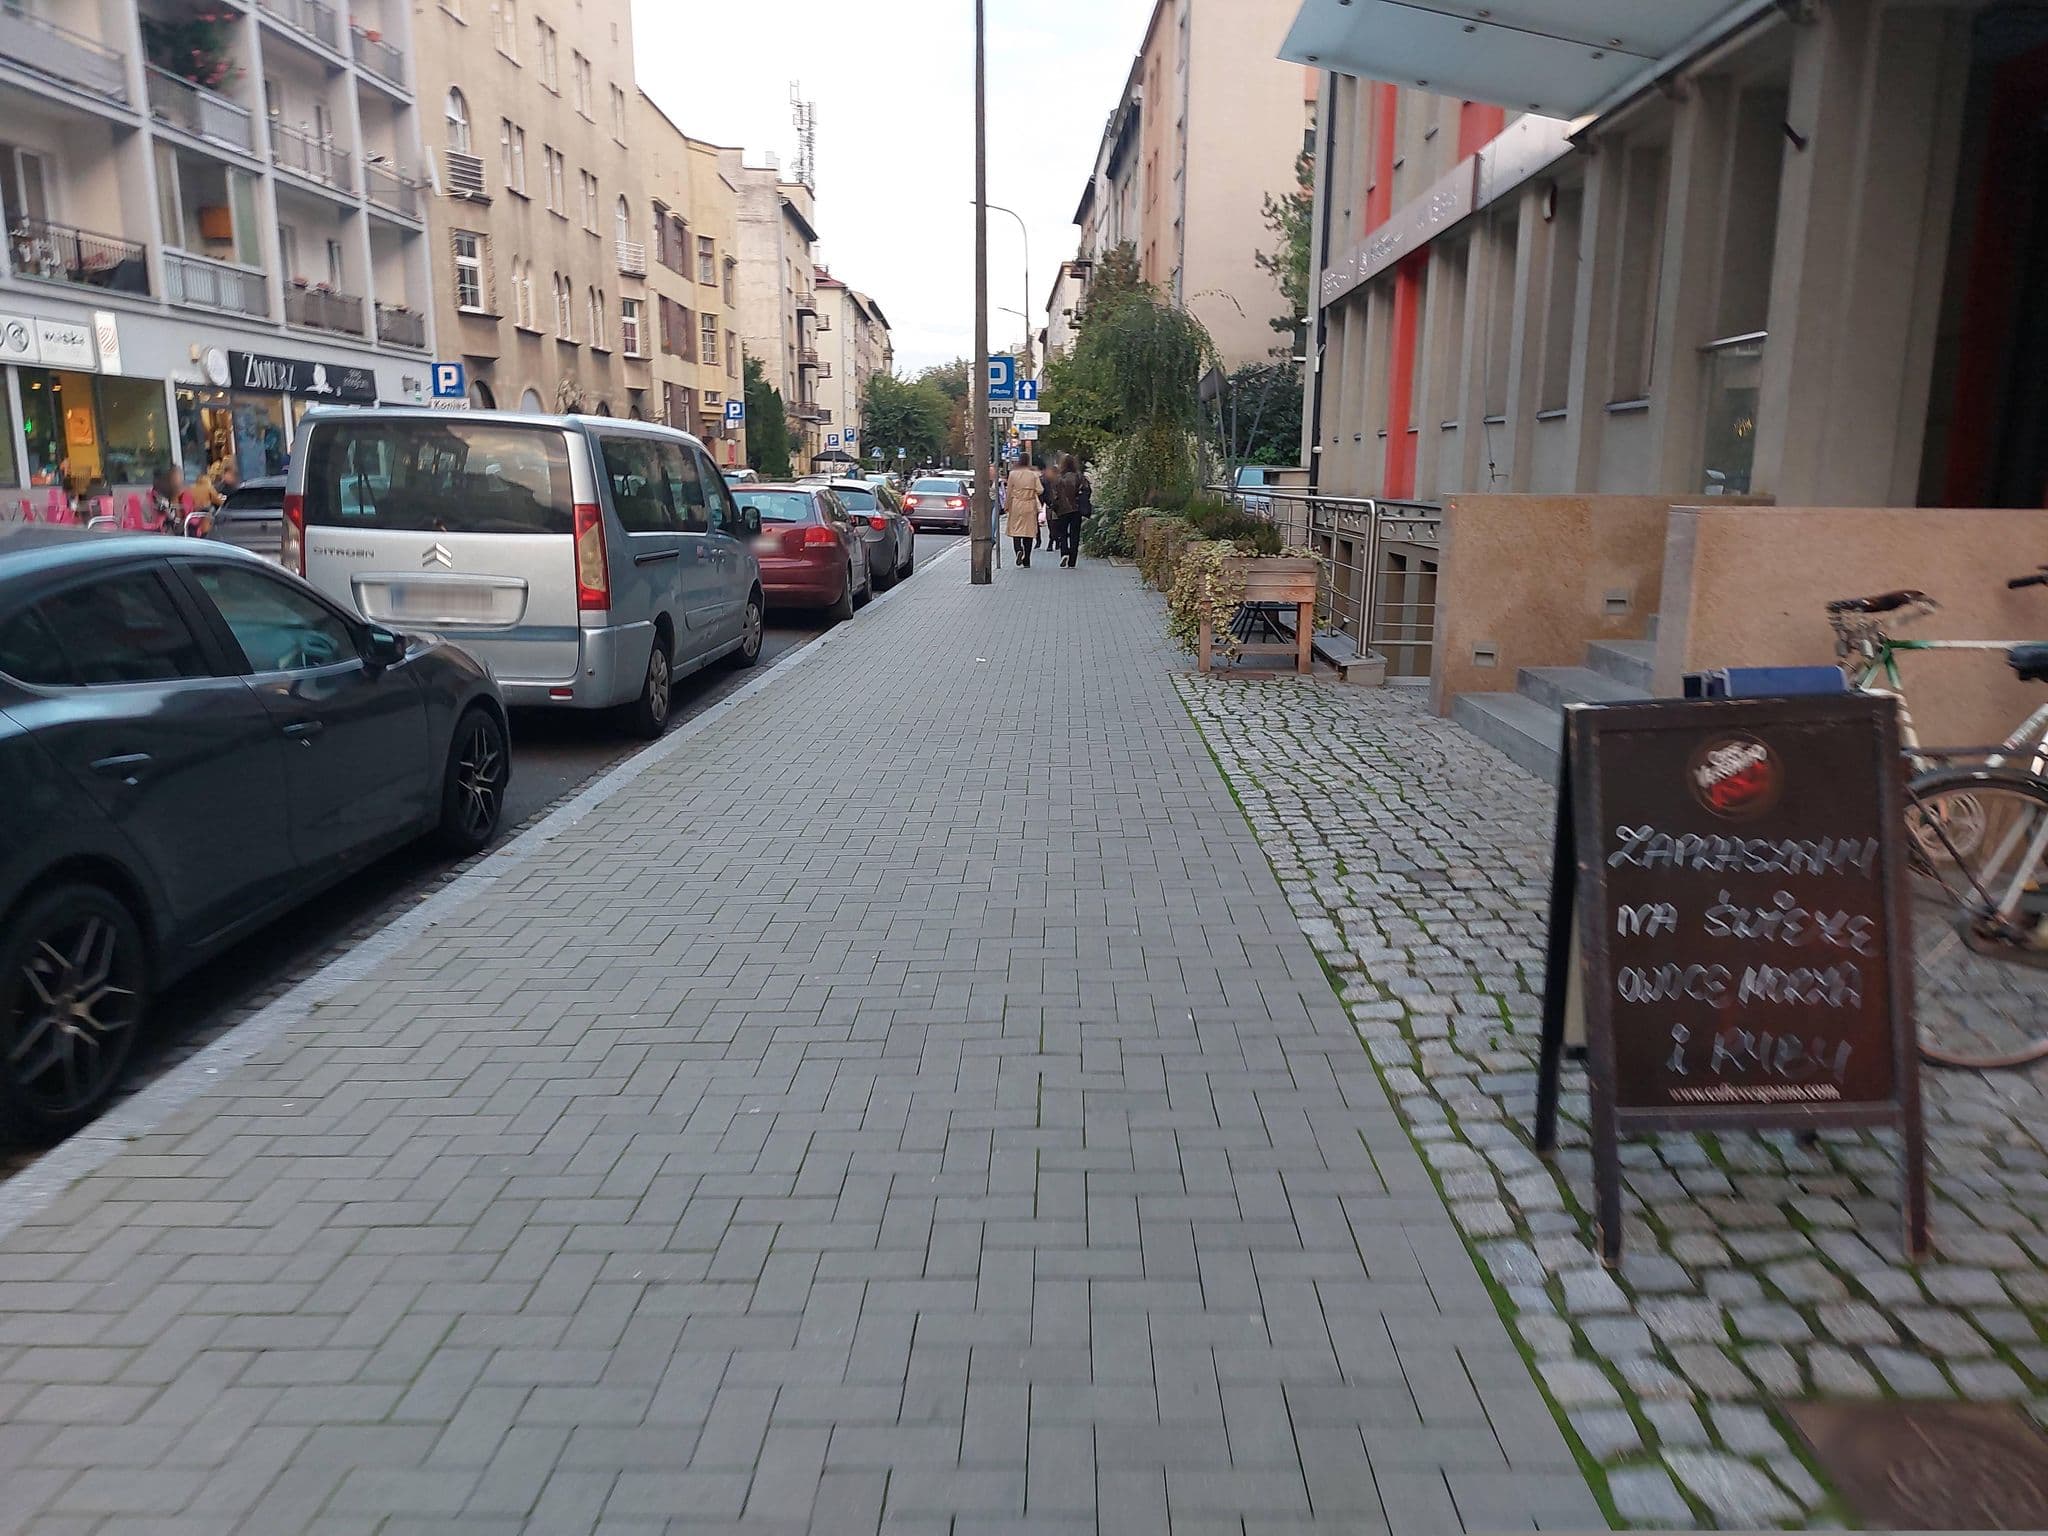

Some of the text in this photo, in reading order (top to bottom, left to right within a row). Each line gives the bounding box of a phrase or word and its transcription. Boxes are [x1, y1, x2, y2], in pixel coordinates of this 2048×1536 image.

[438, 365, 458, 393] P
[988, 362, 1007, 393] P
[728, 403, 741, 417] P
[829, 435, 837, 444] P
[846, 429, 853, 439] P
[1617, 902, 1679, 938] NA
[1617, 962, 1732, 1009] OWOCE
